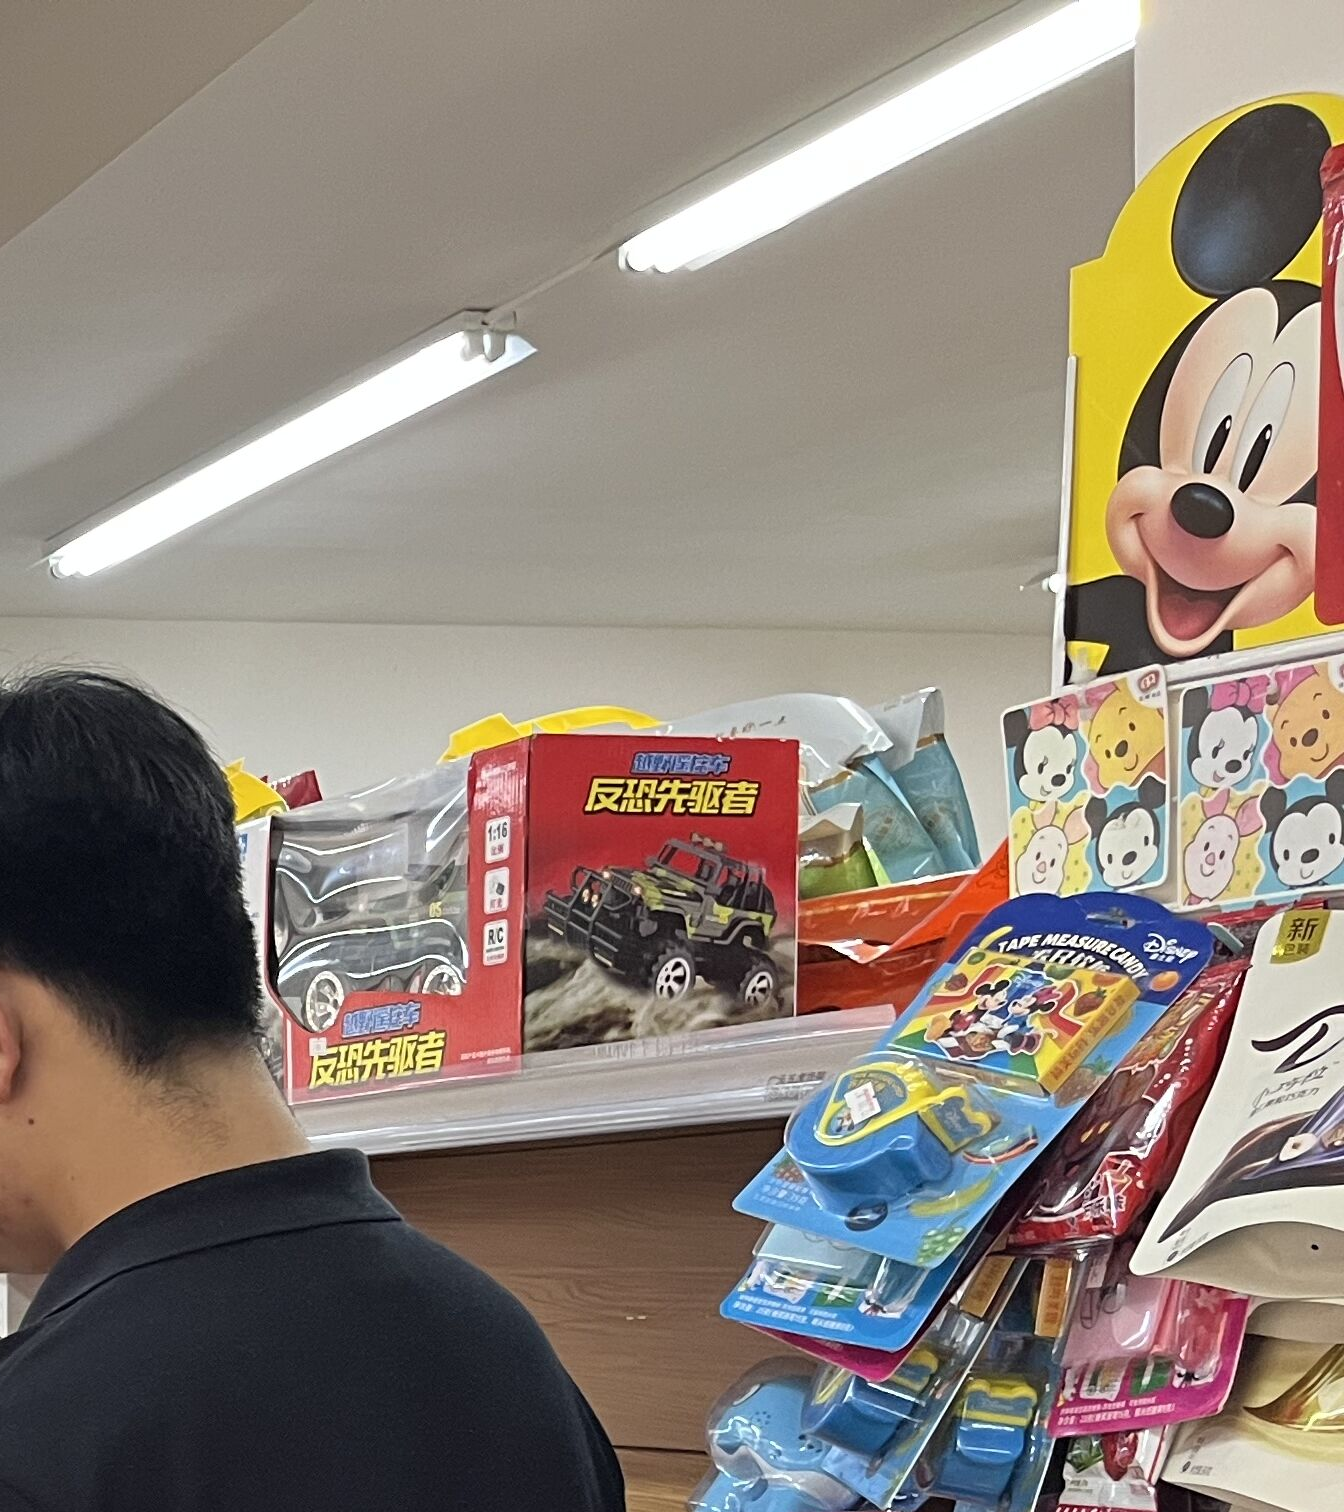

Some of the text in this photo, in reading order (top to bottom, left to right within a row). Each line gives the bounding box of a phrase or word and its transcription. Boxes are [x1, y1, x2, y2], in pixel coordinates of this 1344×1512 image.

[584, 777, 759, 815] 反恐先驱者
[487, 821, 508, 842] 1:16
[487, 926, 504, 945] R/C
[1287, 917, 1319, 942] 新
[998, 934, 1039, 954] TAPE
[1041, 933, 1116, 960] MEASURE
[1109, 945, 1149, 980] CANDY
[310, 1031, 446, 1088] 反恐先驱者
